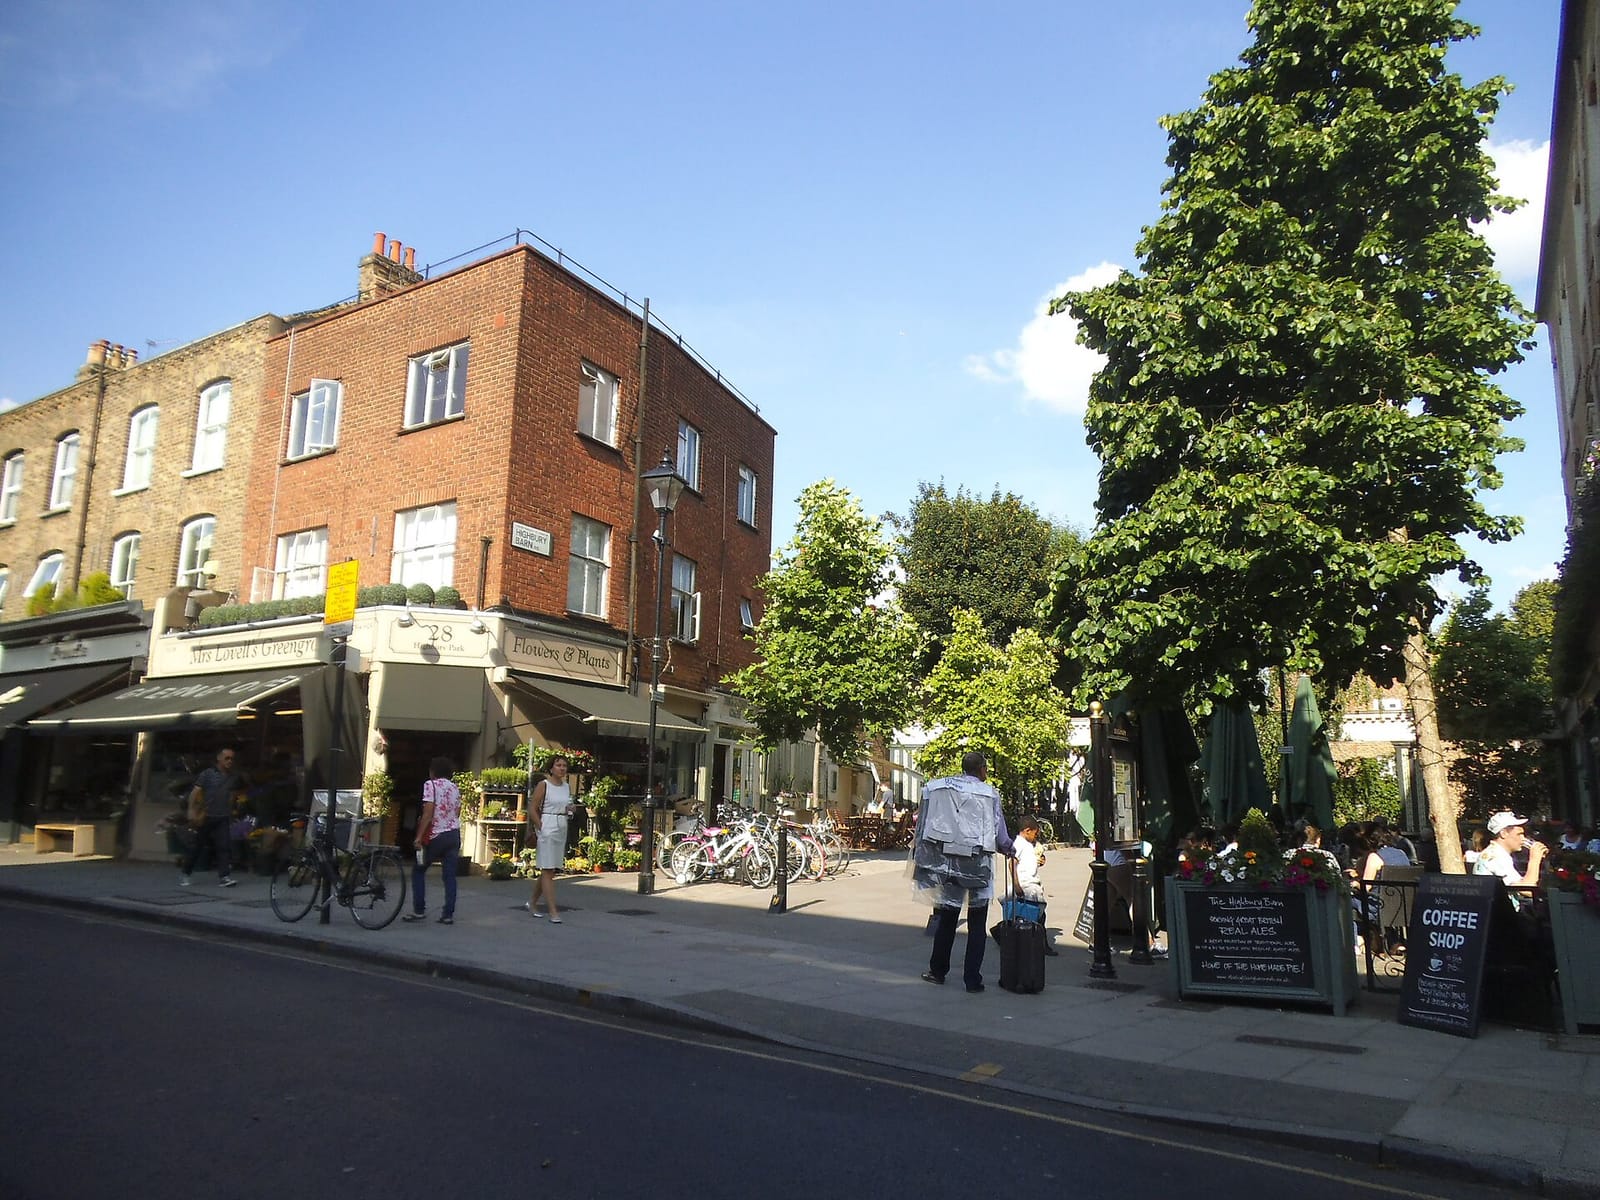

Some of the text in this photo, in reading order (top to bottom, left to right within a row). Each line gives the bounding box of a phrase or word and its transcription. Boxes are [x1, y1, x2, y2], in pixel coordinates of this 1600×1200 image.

[515, 528, 547, 544] HIGHBURY
[515, 536, 533, 549] BARN
[428, 624, 453, 642] 28
[190, 646, 212, 665] Mrs
[215, 639, 258, 662] Lovell's
[448, 644, 465, 652] Park
[513, 636, 610, 669] Flowers & Plants
[1208, 896, 1226, 906] The
[1229, 896, 1262, 910] Highbury
[1422, 908, 1479, 930] COFFEE
[1219, 926, 1277, 936] REAL ALES
[1428, 931, 1465, 950] SHOP
[1201, 960, 1221, 970] HOME
[1223, 962, 1233, 970] OF
[1233, 962, 1249, 971] THE
